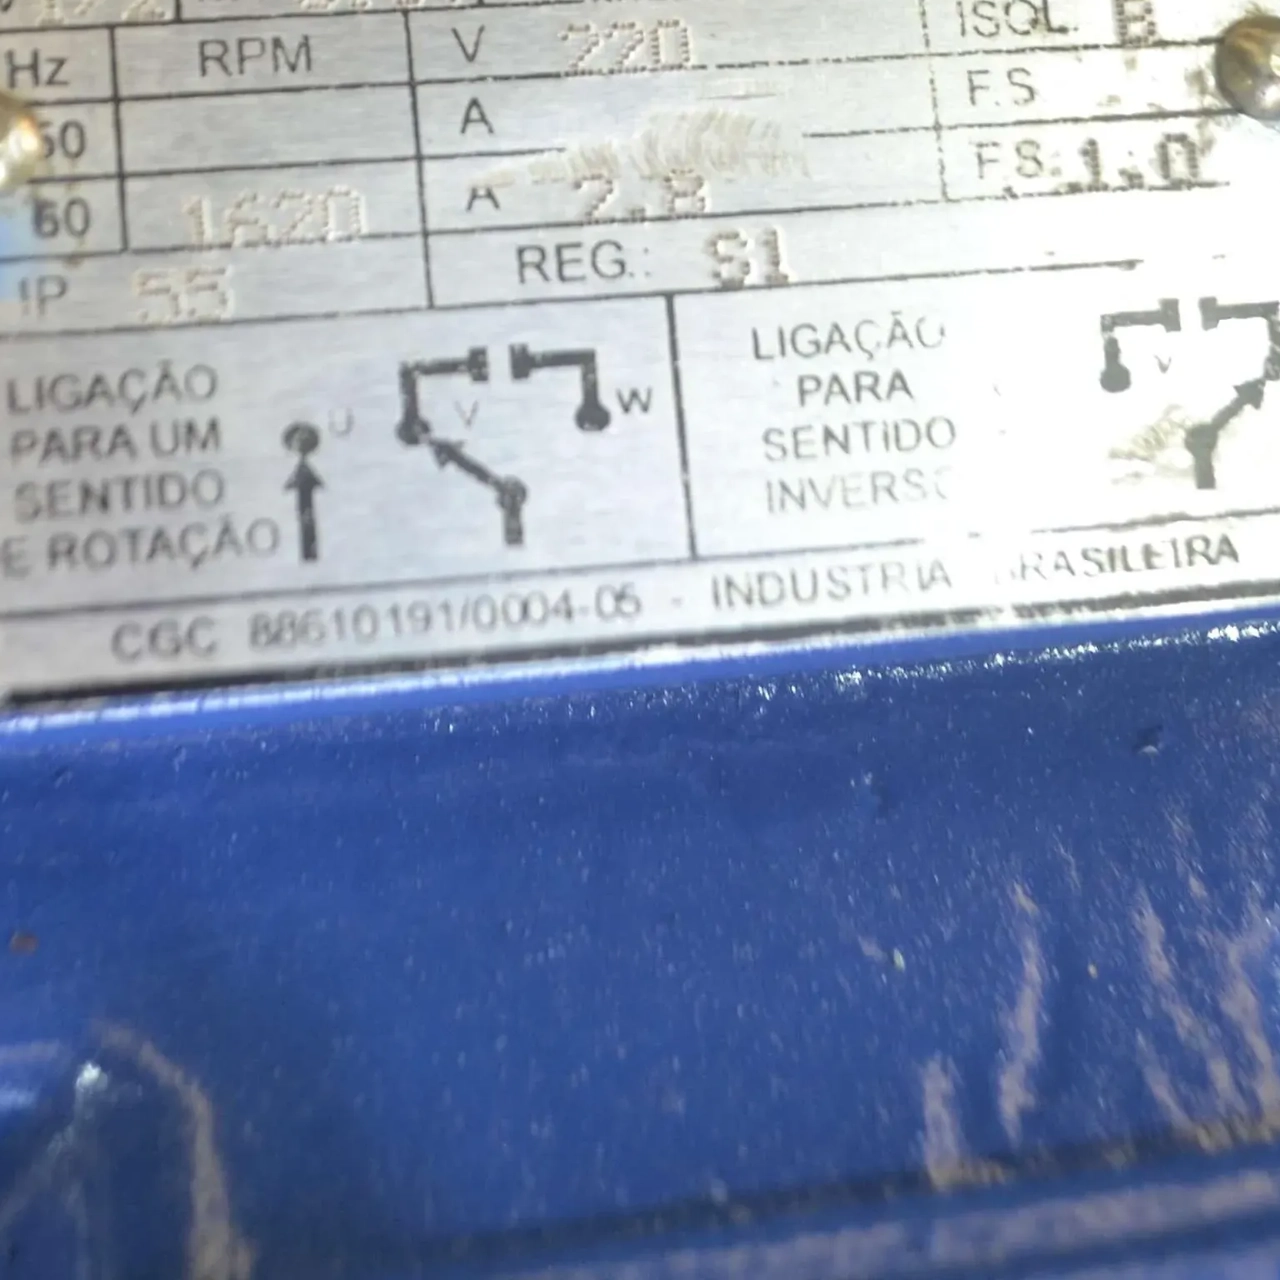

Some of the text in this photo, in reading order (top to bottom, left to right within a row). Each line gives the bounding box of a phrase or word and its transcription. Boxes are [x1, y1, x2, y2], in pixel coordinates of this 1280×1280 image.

[5, 48, 70, 89] Hz
[198, 35, 313, 78] RPM
[451, 19, 694, 76] V 220
[460, 96, 495, 136] A
[33, 197, 91, 239] 60
[704, 226, 791, 291] S1
[751, 310, 946, 361] LIGAÇÃO
[6, 359, 219, 416] LIGAÇÃO
[616, 386, 653, 416] W
[797, 368, 915, 408] PARA
[10, 417, 222, 468] PARA UM
[761, 416, 957, 462] SENTIDO
[14, 468, 227, 524] SENTIDO
[47, 514, 281, 572] ROTAÇÃO
[111, 615, 218, 665] CGC
[711, 558, 953, 611] INDUSTRIA
[996, 533, 1240, 585] RASILEIRA
